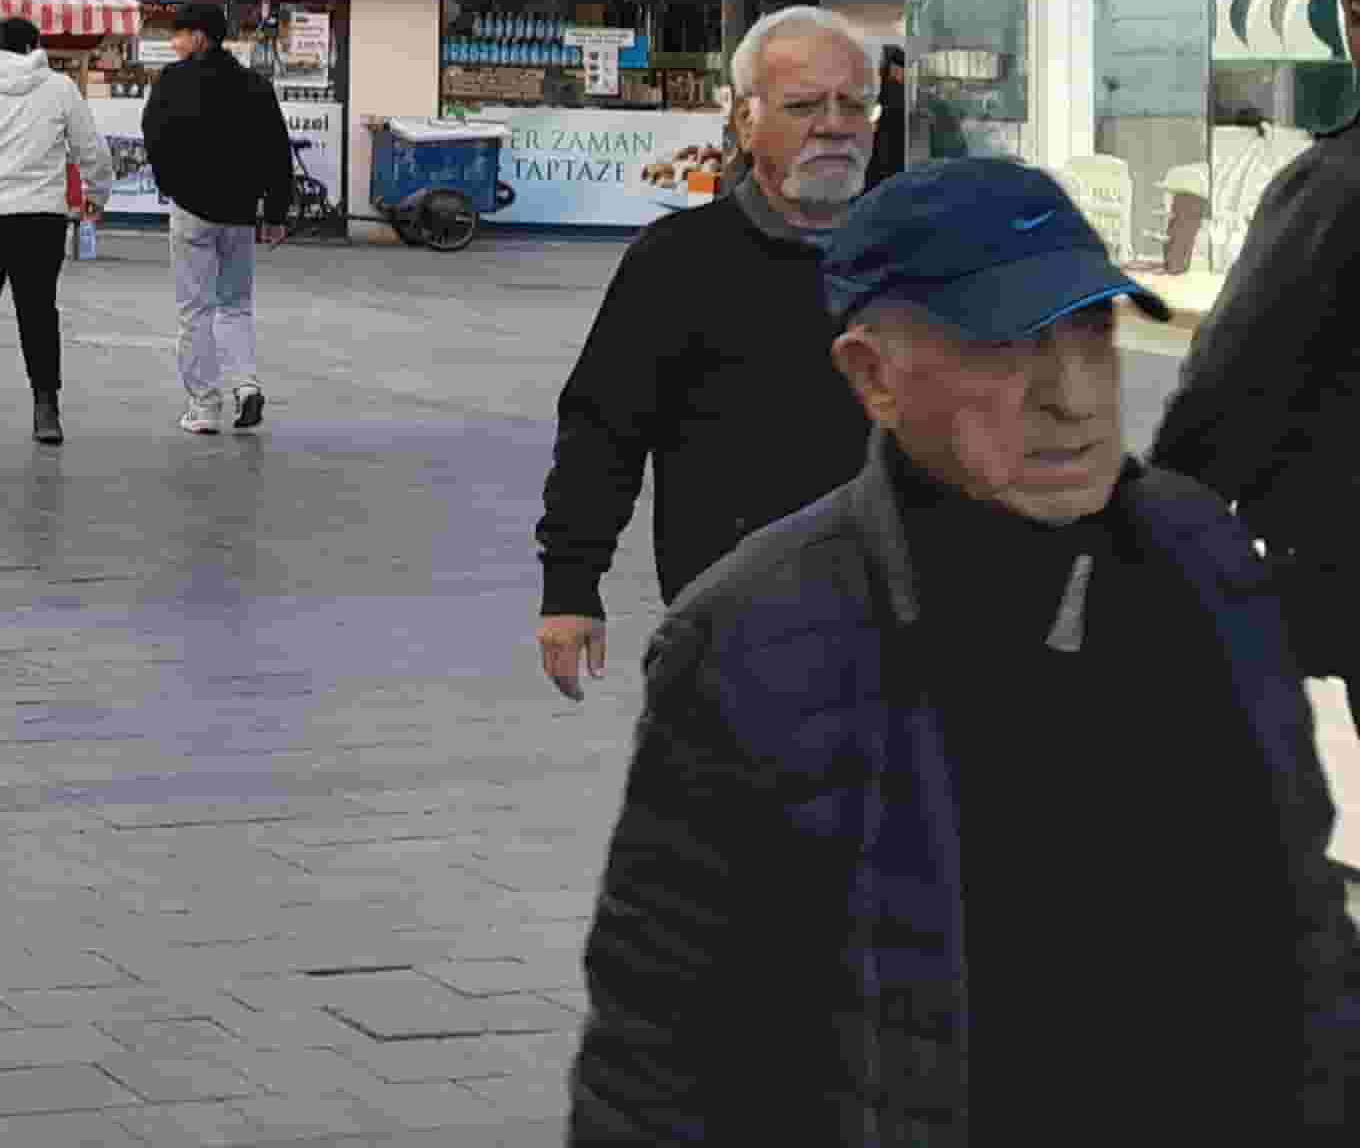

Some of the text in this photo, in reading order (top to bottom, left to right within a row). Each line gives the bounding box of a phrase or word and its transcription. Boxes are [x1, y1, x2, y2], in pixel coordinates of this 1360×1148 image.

[510, 129, 655, 155] ER ZAMAN
[512, 158, 626, 183] TAPTAZE
